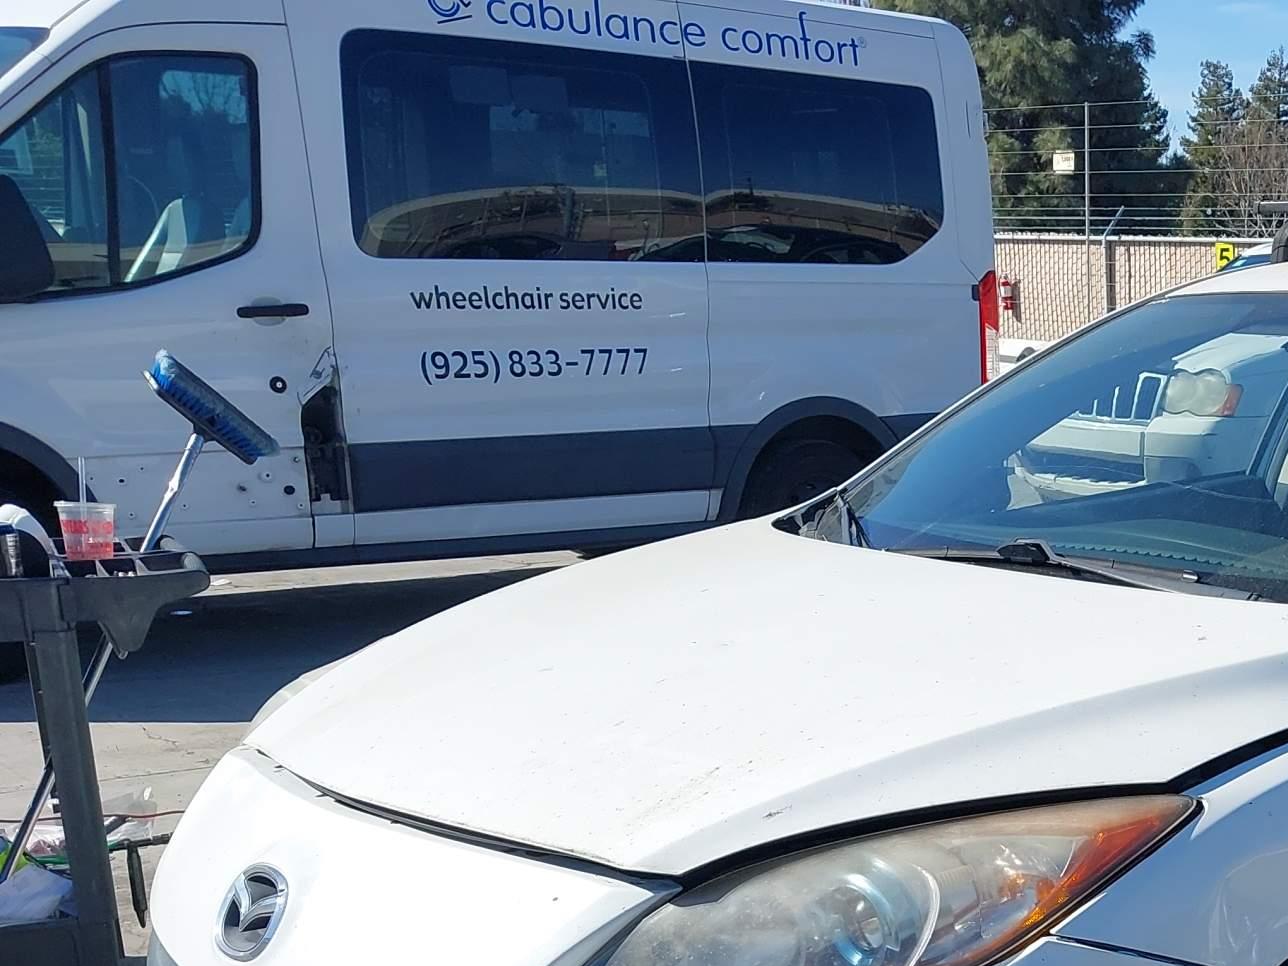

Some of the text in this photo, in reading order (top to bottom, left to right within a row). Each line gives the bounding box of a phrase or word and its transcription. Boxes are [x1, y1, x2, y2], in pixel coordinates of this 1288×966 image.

[487, 0, 706, 47] cabulance
[1219, 247, 1231, 268] 5
[410, 285, 643, 310] wheelchair service
[420, 348, 648, 385] (925) 833-7777
